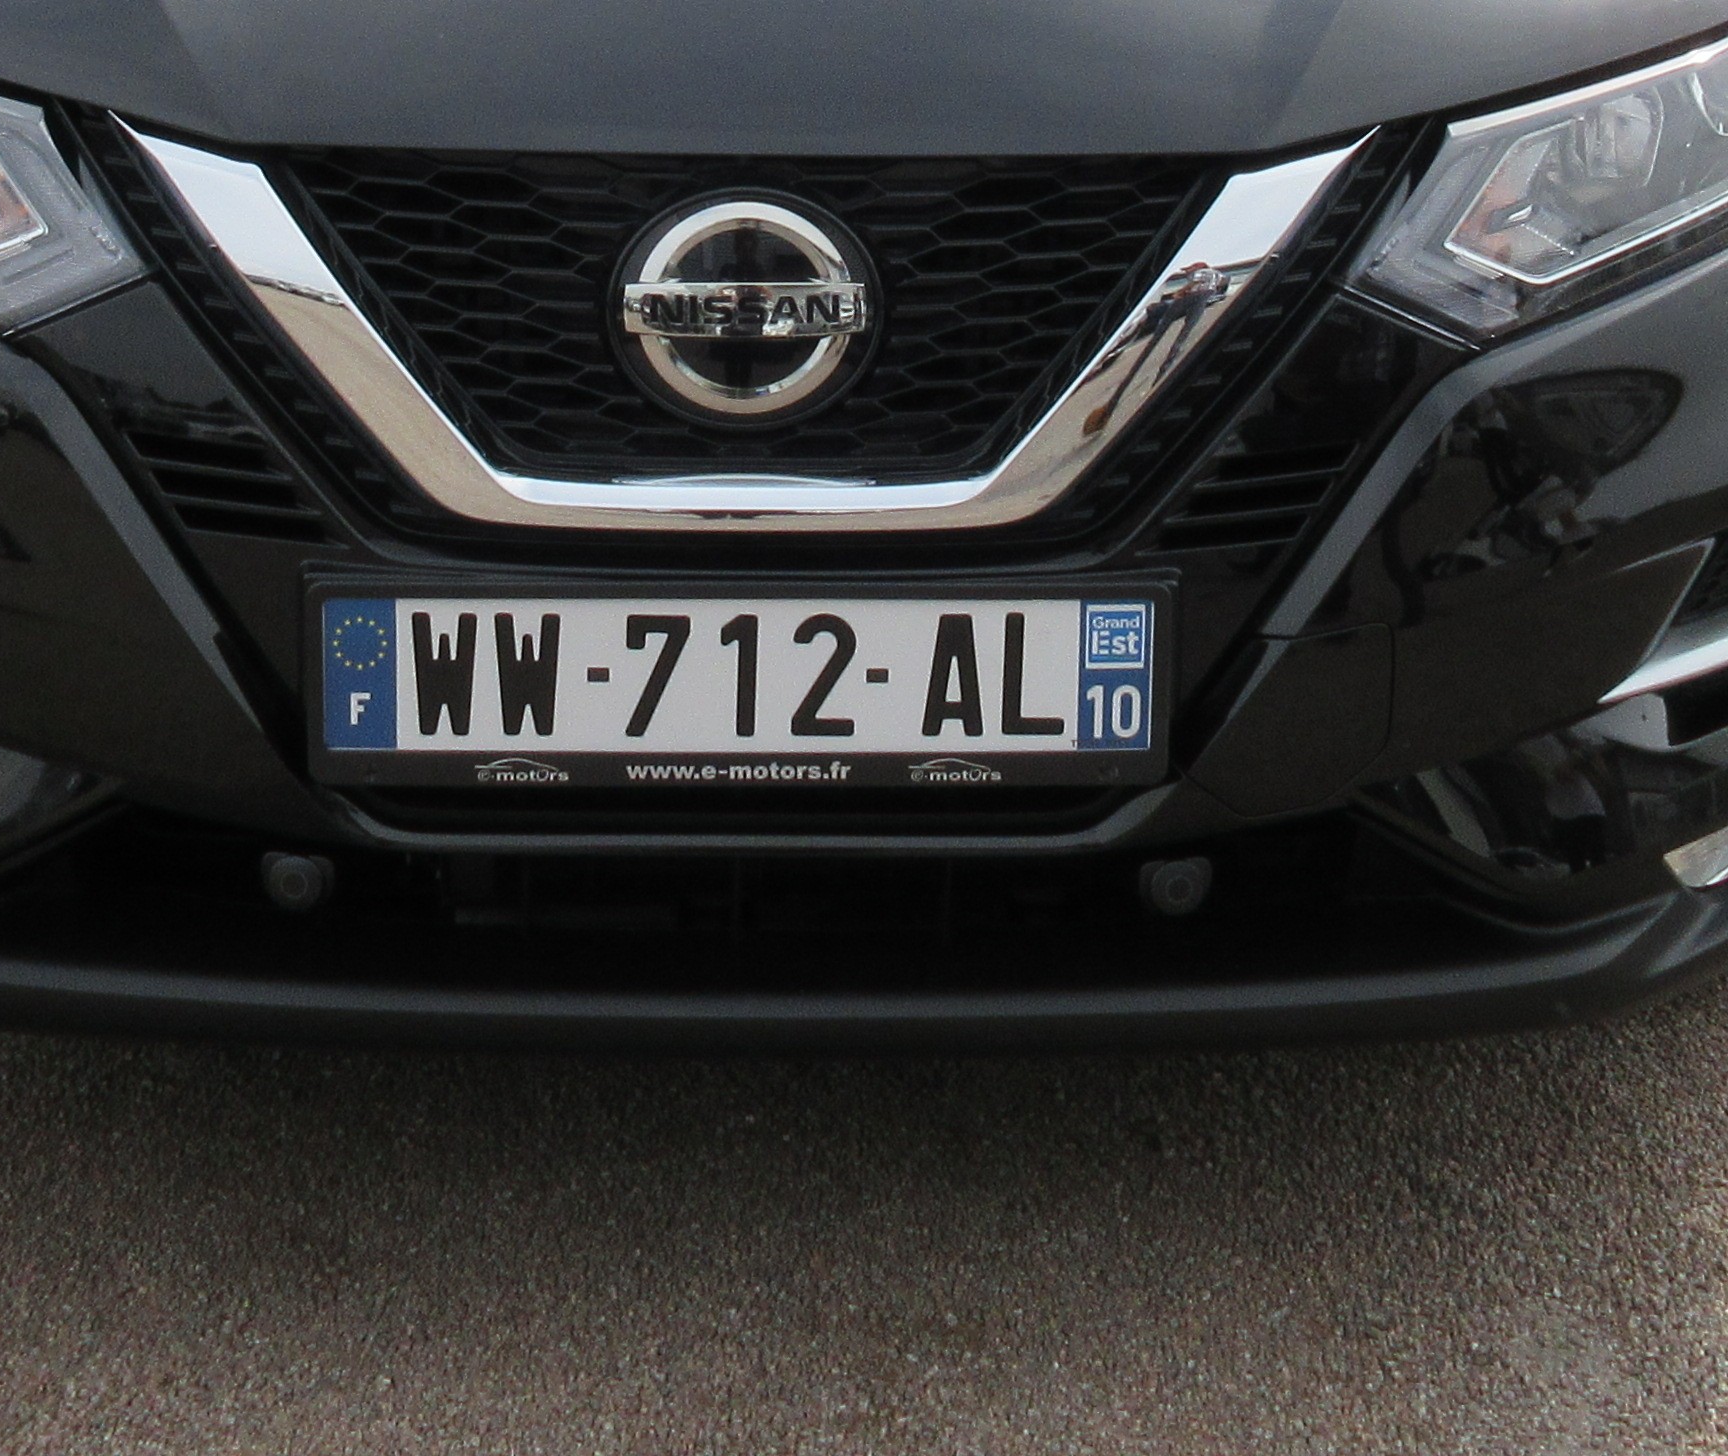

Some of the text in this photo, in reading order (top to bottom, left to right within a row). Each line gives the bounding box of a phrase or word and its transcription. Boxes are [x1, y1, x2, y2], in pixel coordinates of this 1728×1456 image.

[648, 294, 841, 325] NISSAN
[1091, 616, 1140, 630] Grand
[1090, 630, 1140, 656] Est
[411, 611, 1065, 737] WW-712-AL
[349, 692, 371, 726] F
[1085, 684, 1142, 740] 10
[625, 760, 852, 780] www.e-motors.fr
